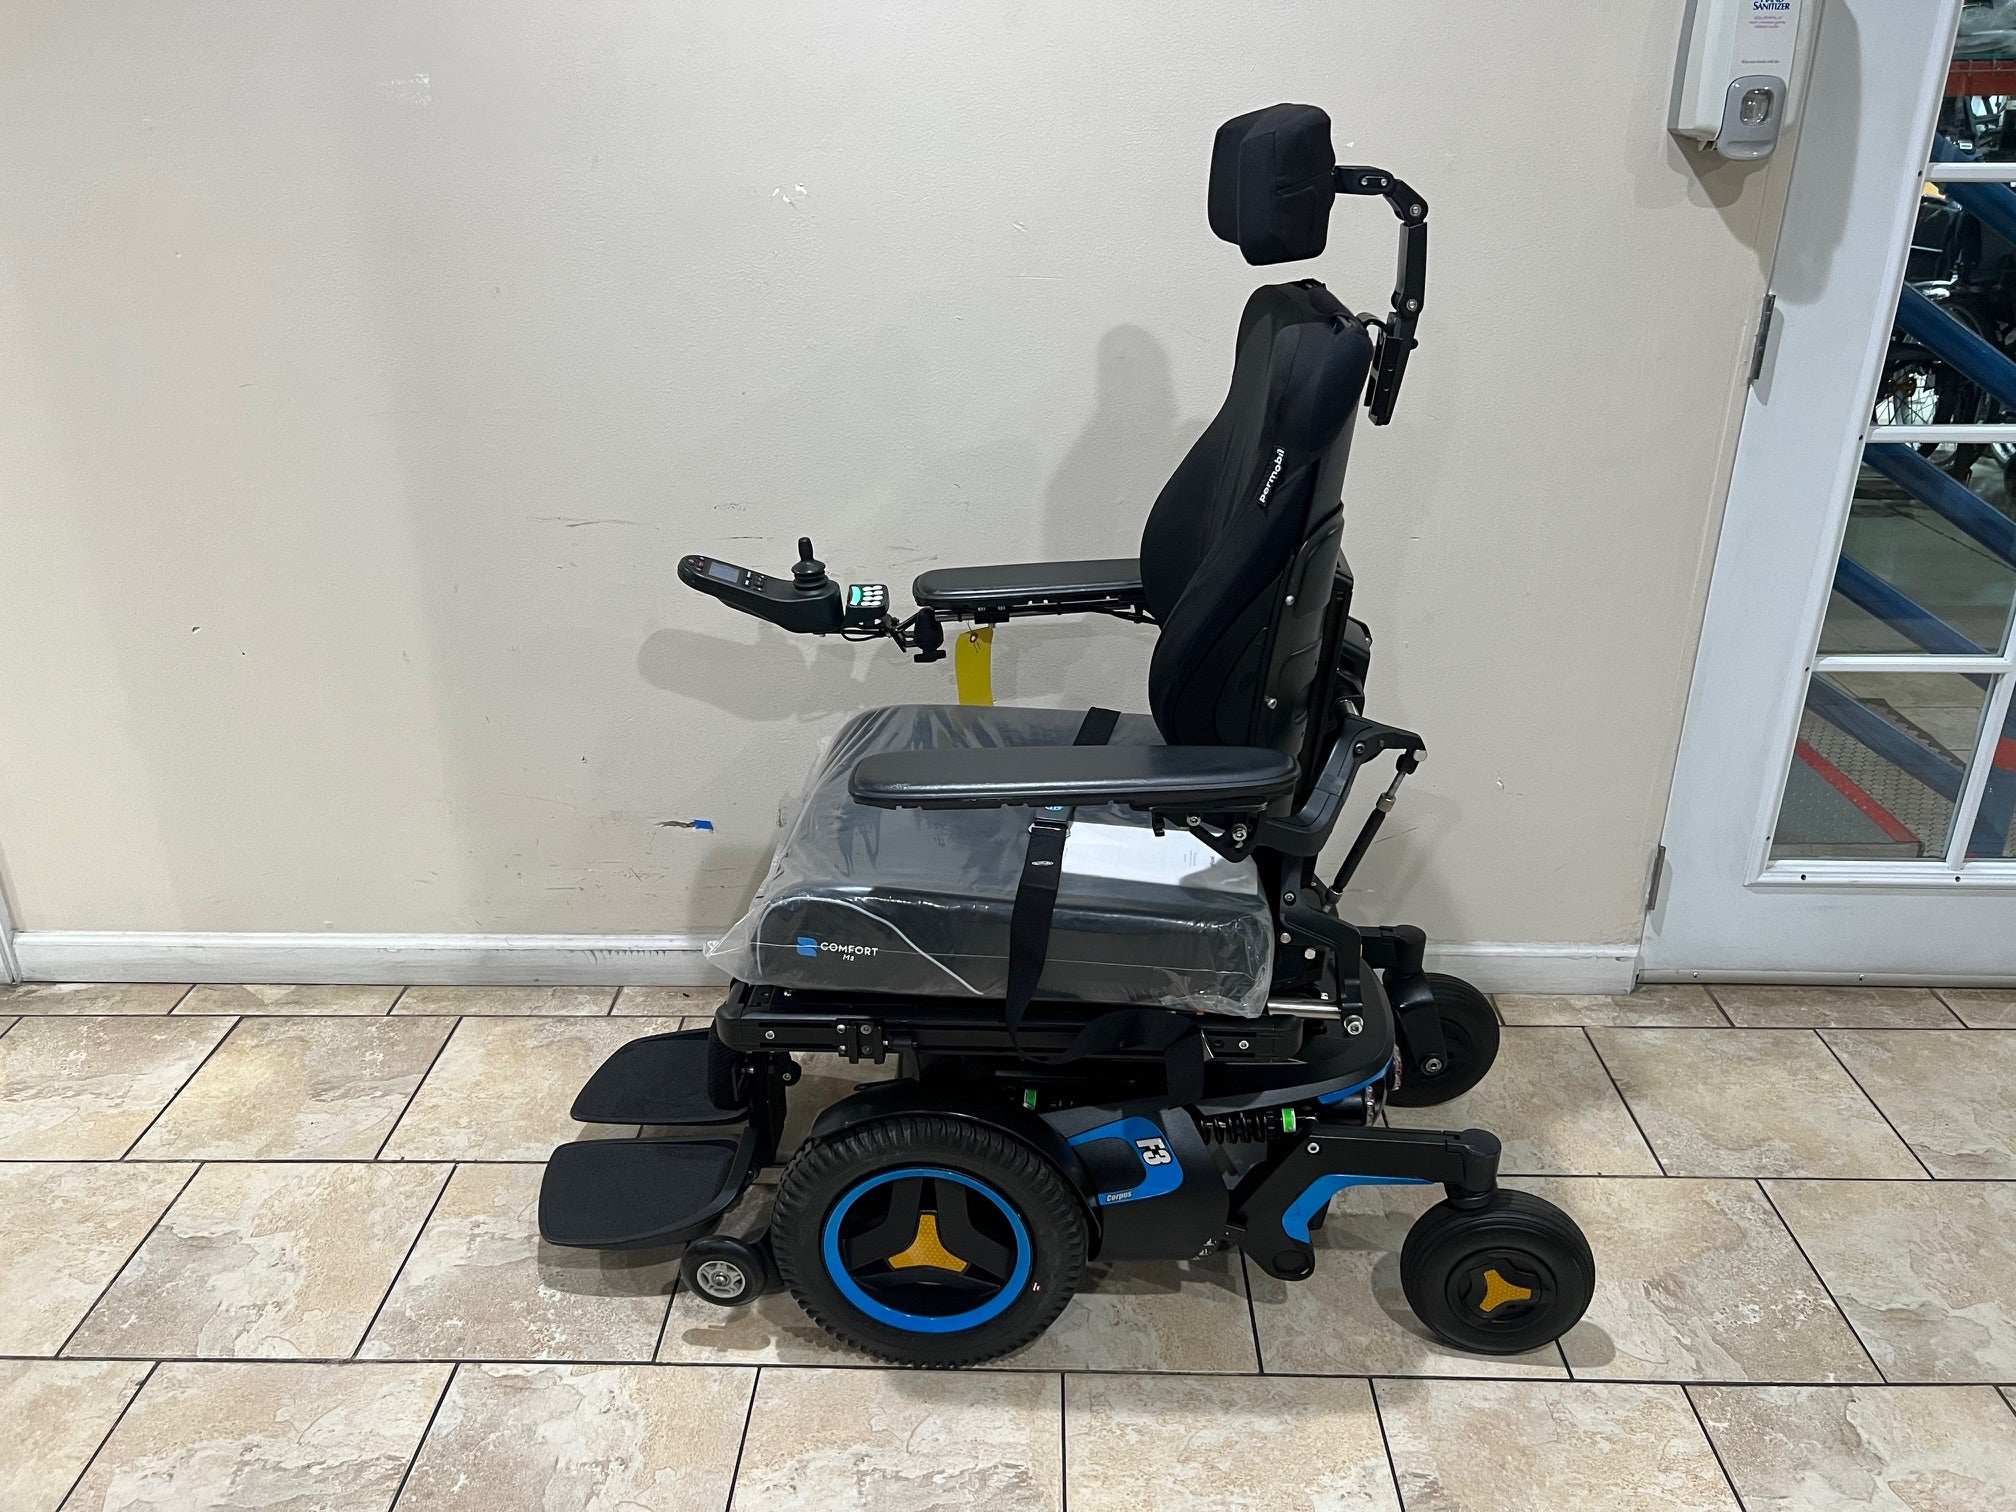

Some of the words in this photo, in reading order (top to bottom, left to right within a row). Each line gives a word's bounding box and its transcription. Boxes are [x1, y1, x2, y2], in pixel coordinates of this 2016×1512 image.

[1753, 2, 1790, 10] SANITIZER
[1259, 448, 1285, 503] permobil
[820, 942, 878, 956] COMFORT
[1135, 1138, 1172, 1165] F3
[1106, 1191, 1132, 1202] Corpus
